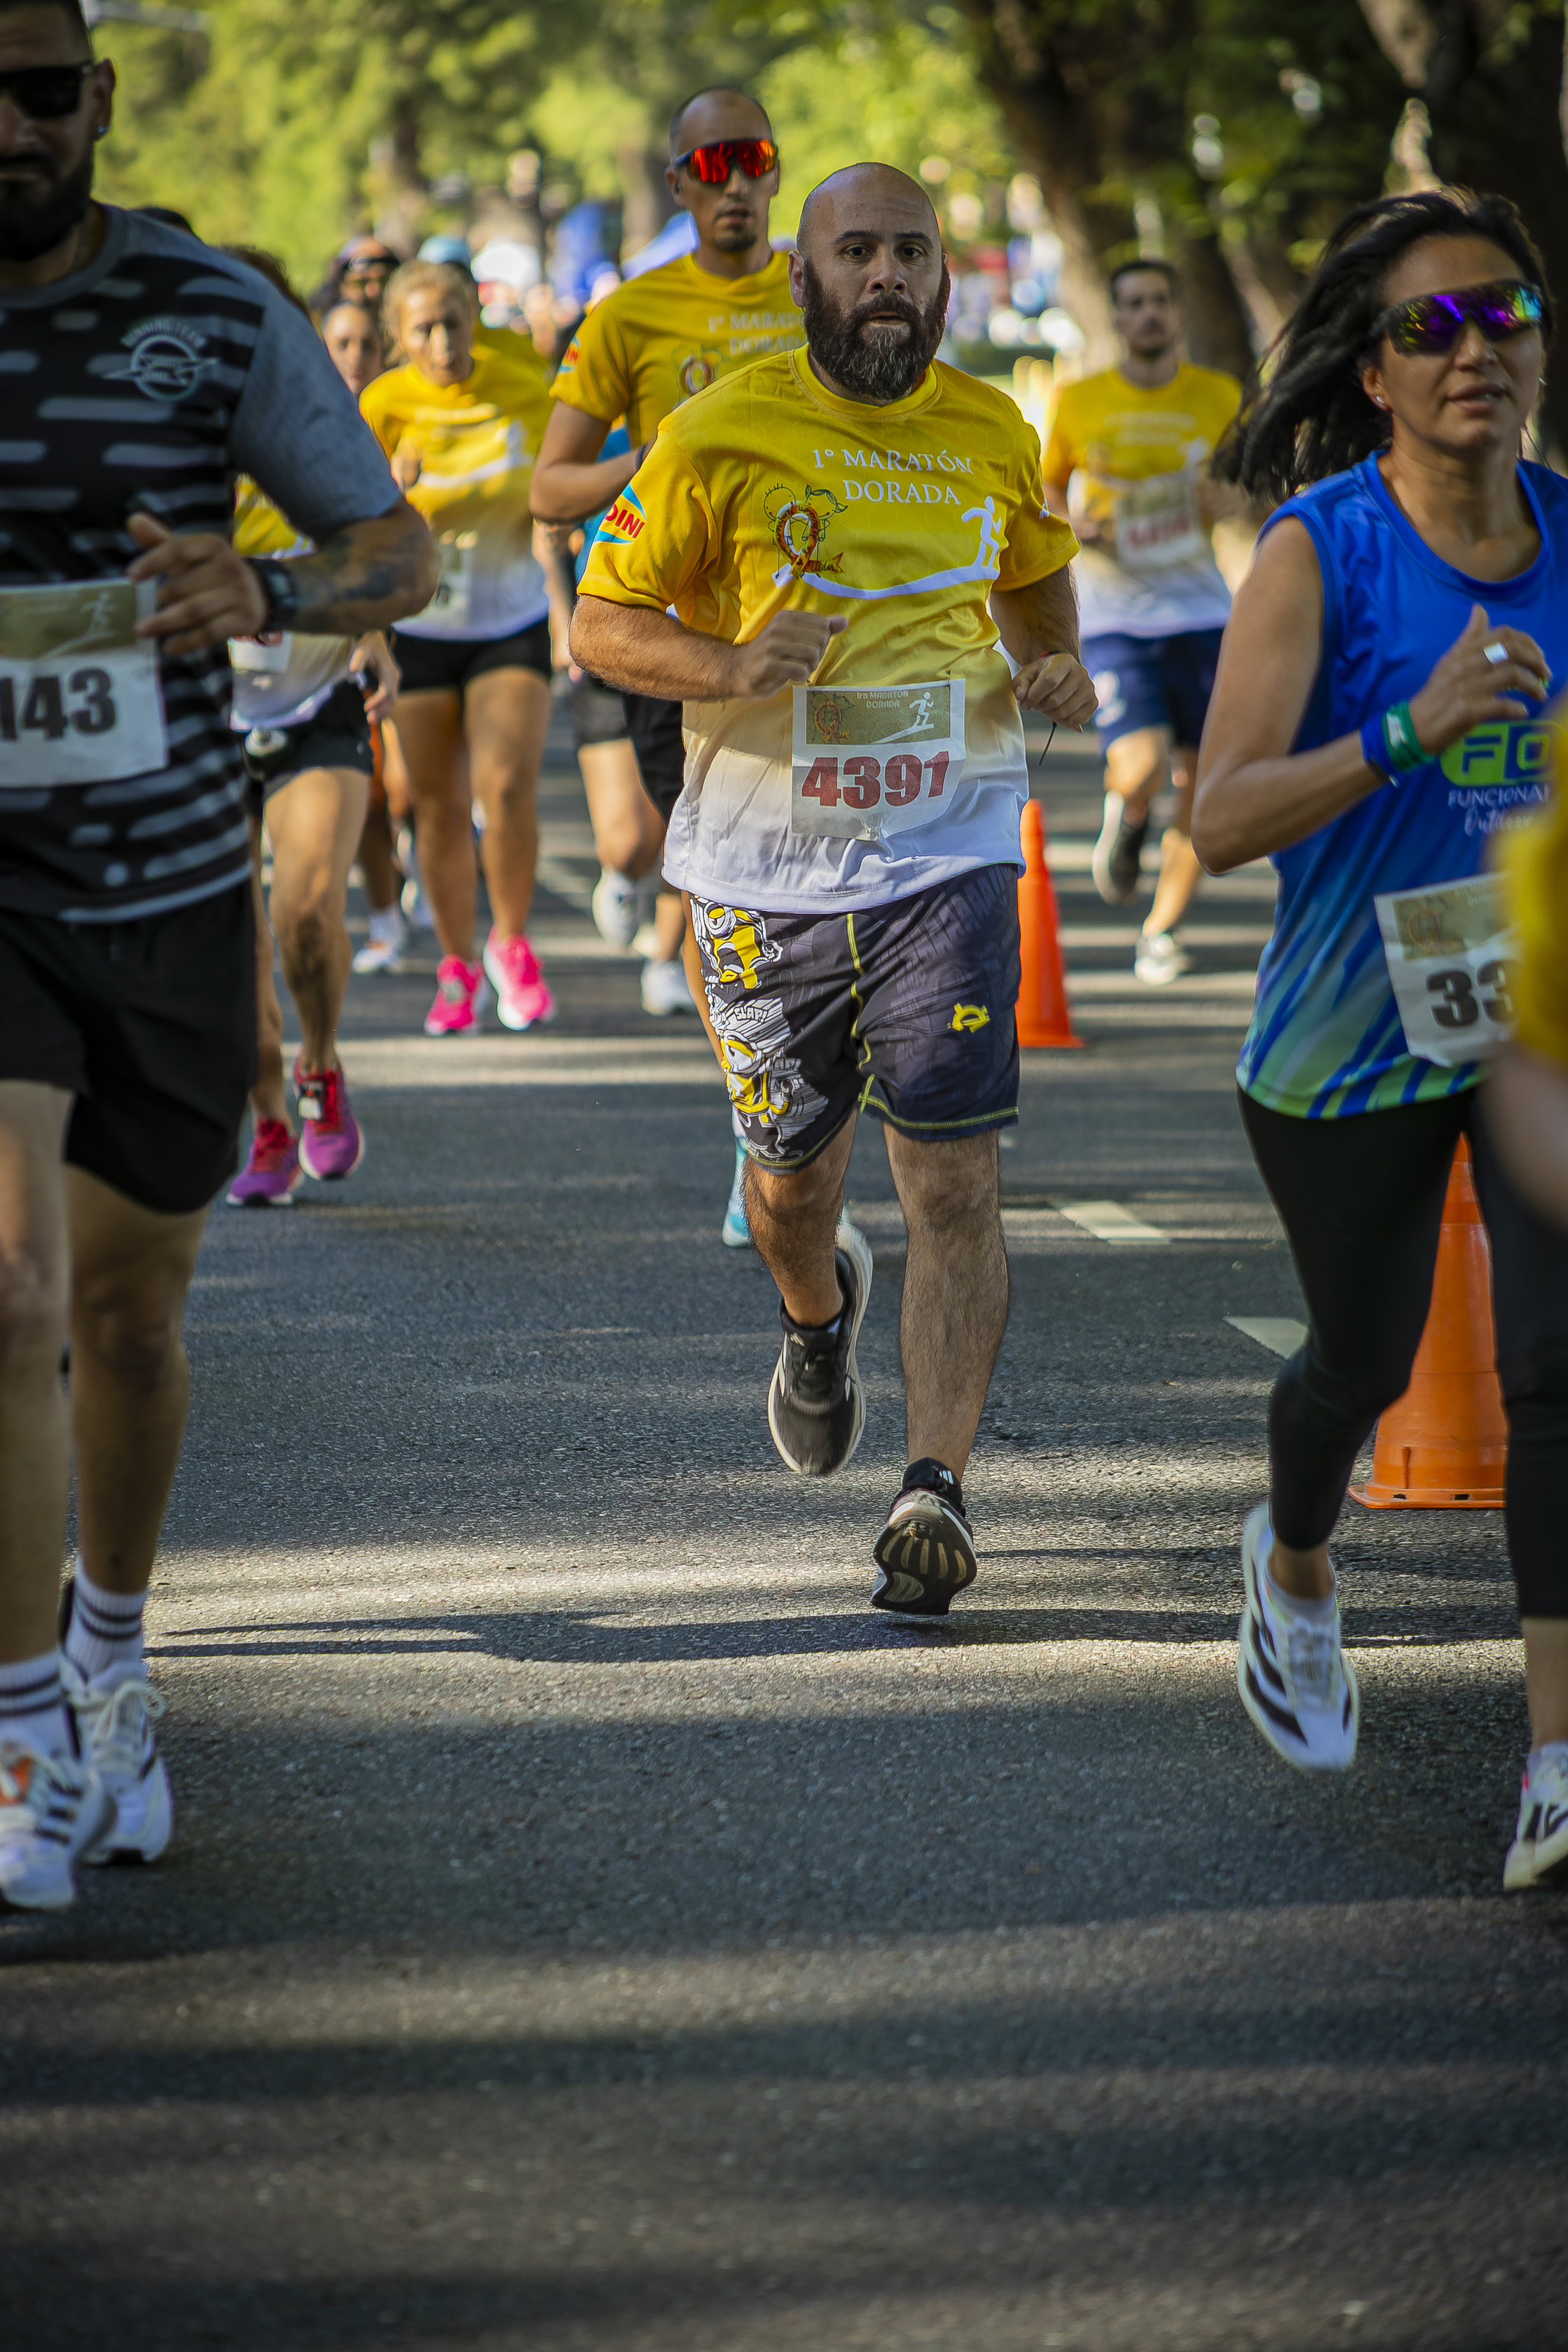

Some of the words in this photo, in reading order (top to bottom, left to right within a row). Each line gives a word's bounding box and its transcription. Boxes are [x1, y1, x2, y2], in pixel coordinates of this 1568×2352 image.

[841, 449, 974, 475] MARATÓN
[843, 479, 961, 506] DORADA
[866, 699, 900, 709] DORADA
[802, 751, 950, 809] 4391
[734, 1006, 768, 1022] SLAP!
